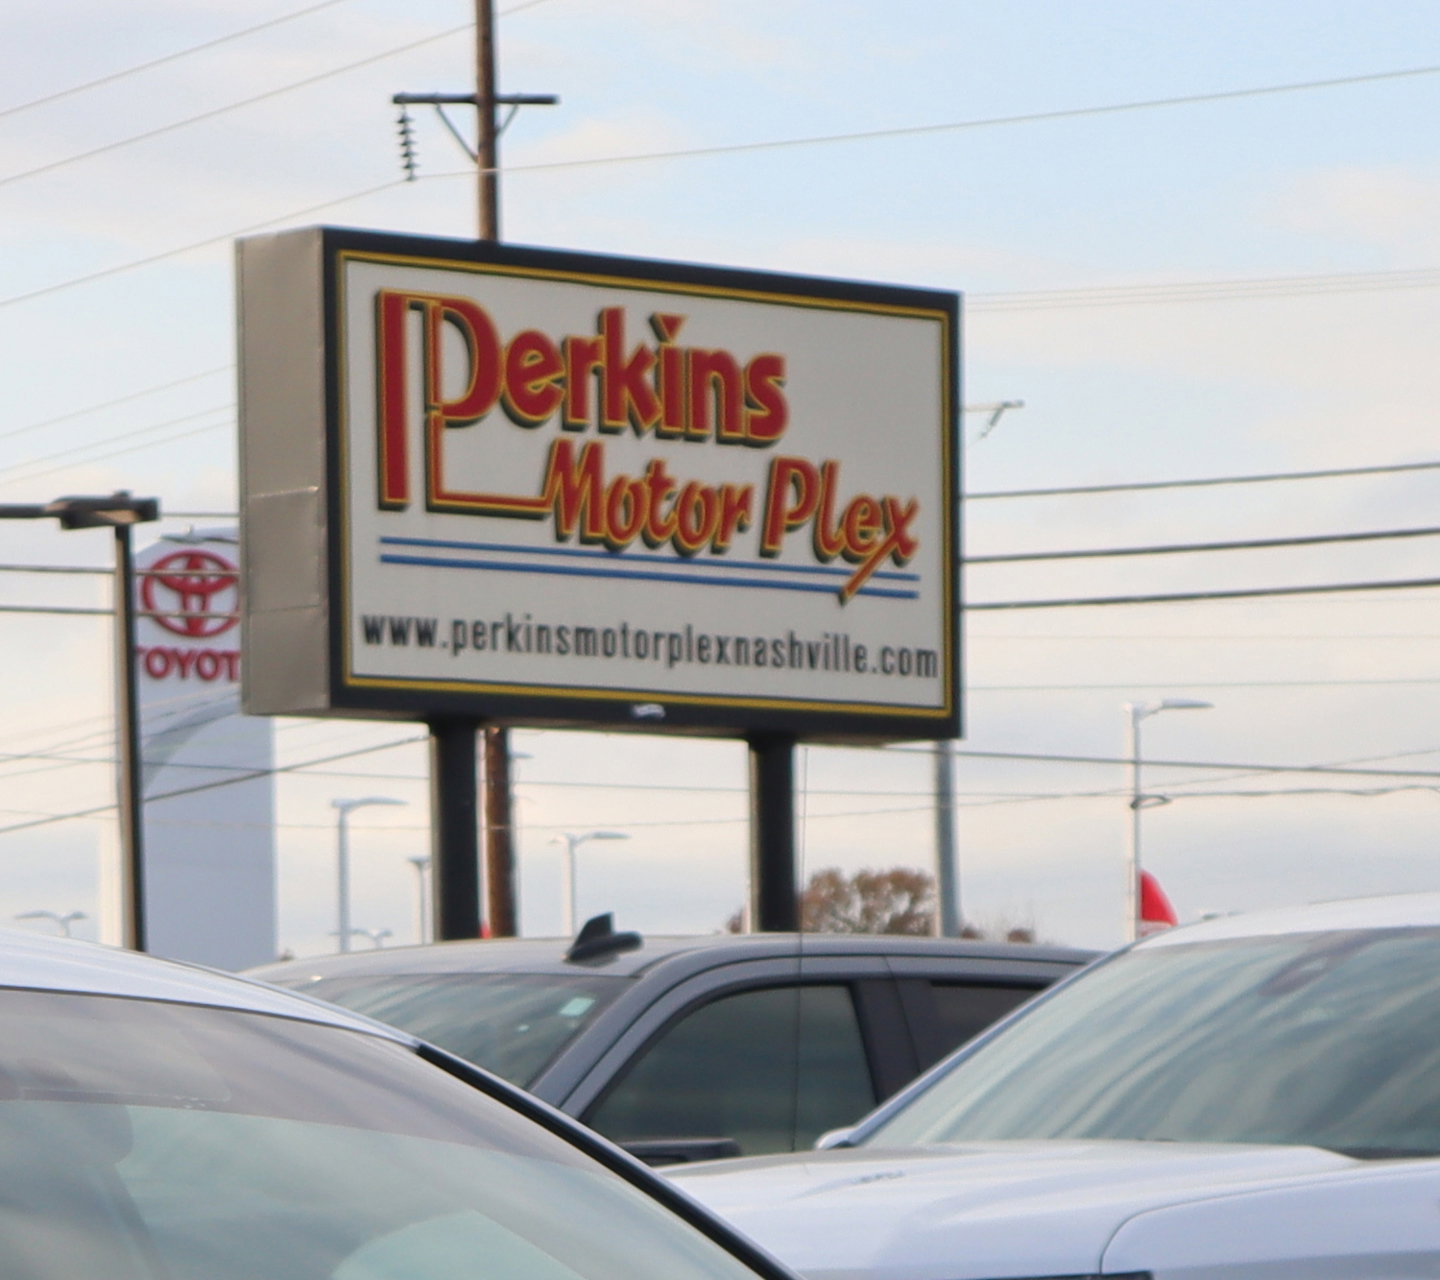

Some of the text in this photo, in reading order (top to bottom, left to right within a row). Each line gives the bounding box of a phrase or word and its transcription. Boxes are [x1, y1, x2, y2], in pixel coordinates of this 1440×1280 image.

[376, 289, 790, 510] Perkins
[542, 437, 920, 605] Motor Plex
[136, 646, 241, 682] OYOT
[361, 612, 940, 680] www.perkinsmotorplexnashville.com
